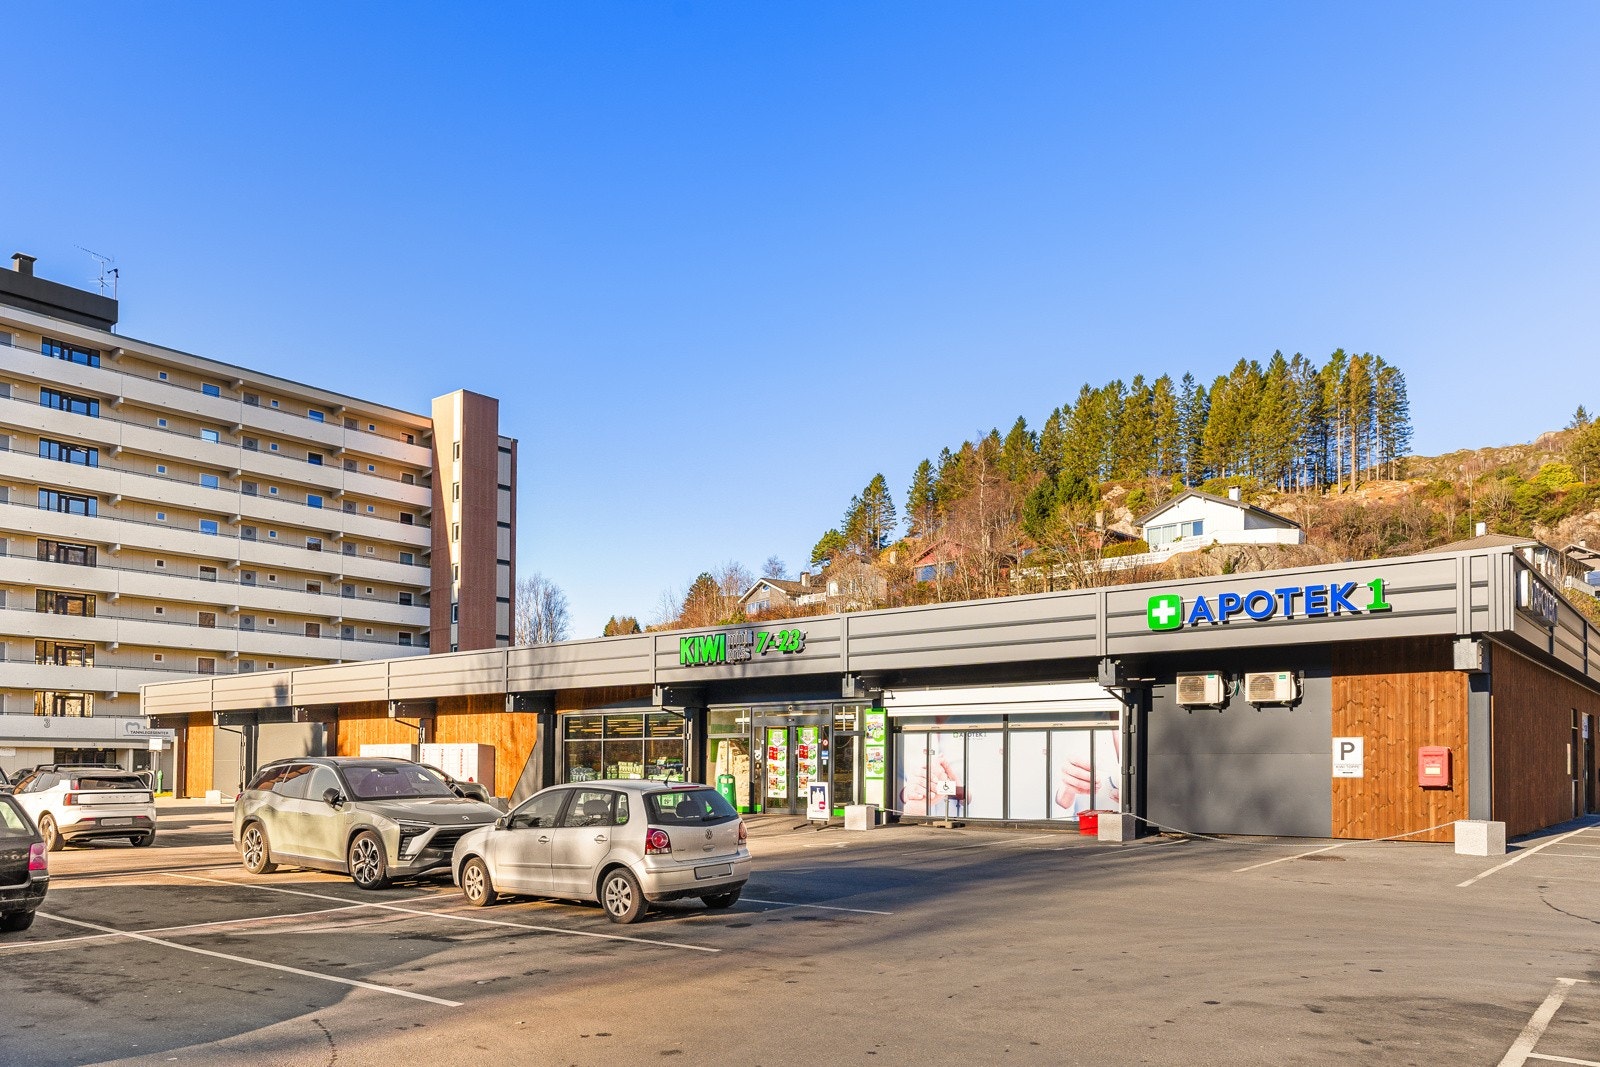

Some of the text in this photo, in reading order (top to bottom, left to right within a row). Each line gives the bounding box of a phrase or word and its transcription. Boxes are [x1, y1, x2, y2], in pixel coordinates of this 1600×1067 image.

[1188, 578, 1391, 623] APOTEK 1
[680, 633, 726, 665] KIWI
[755, 629, 802, 654] 7-23
[43, 718, 51, 729] 3
[1340, 741, 1355, 761] P
